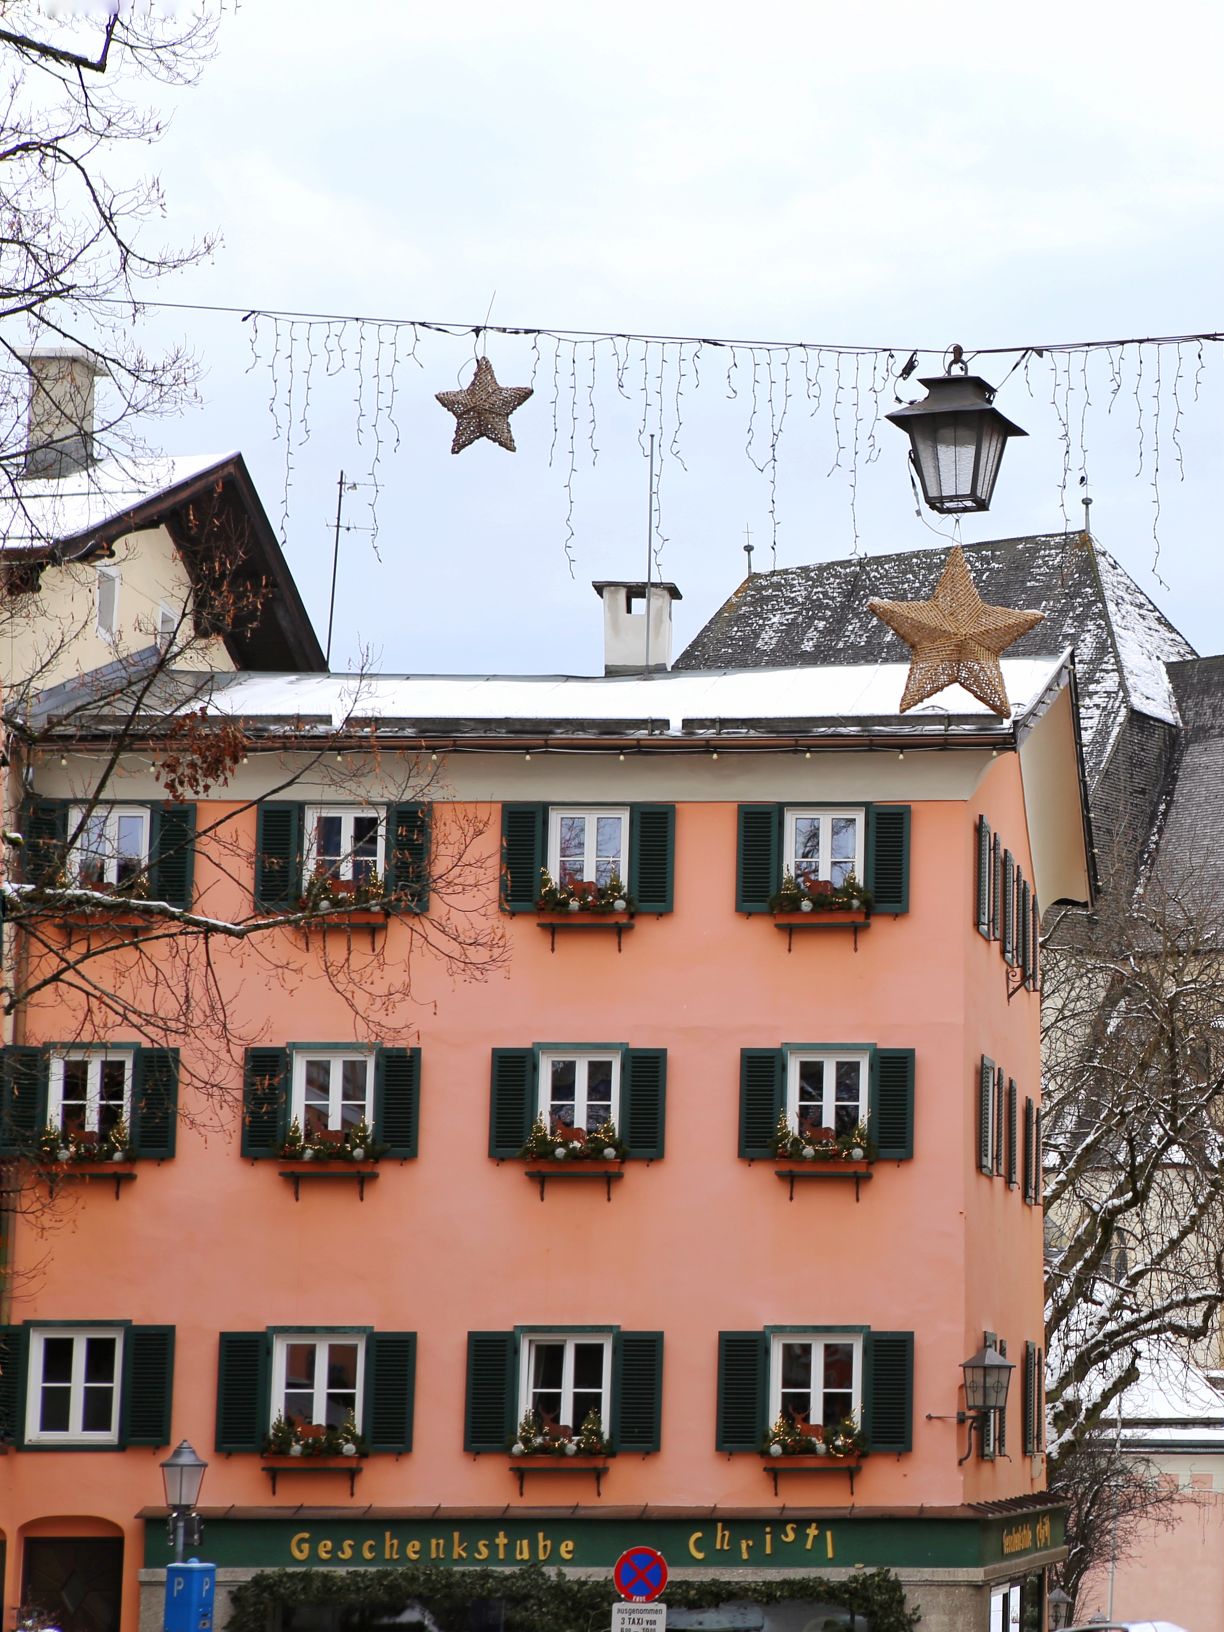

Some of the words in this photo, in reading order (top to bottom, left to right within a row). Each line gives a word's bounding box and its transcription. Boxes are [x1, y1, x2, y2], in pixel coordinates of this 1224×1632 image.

[290, 1531, 575, 1560] Geschenkstube
[688, 1522, 833, 1560] Christl
[173, 1577, 184, 1597] P
[203, 1577, 210, 1598] P
[620, 1617, 626, 1625] 3
[628, 1617, 644, 1626] TAXI
